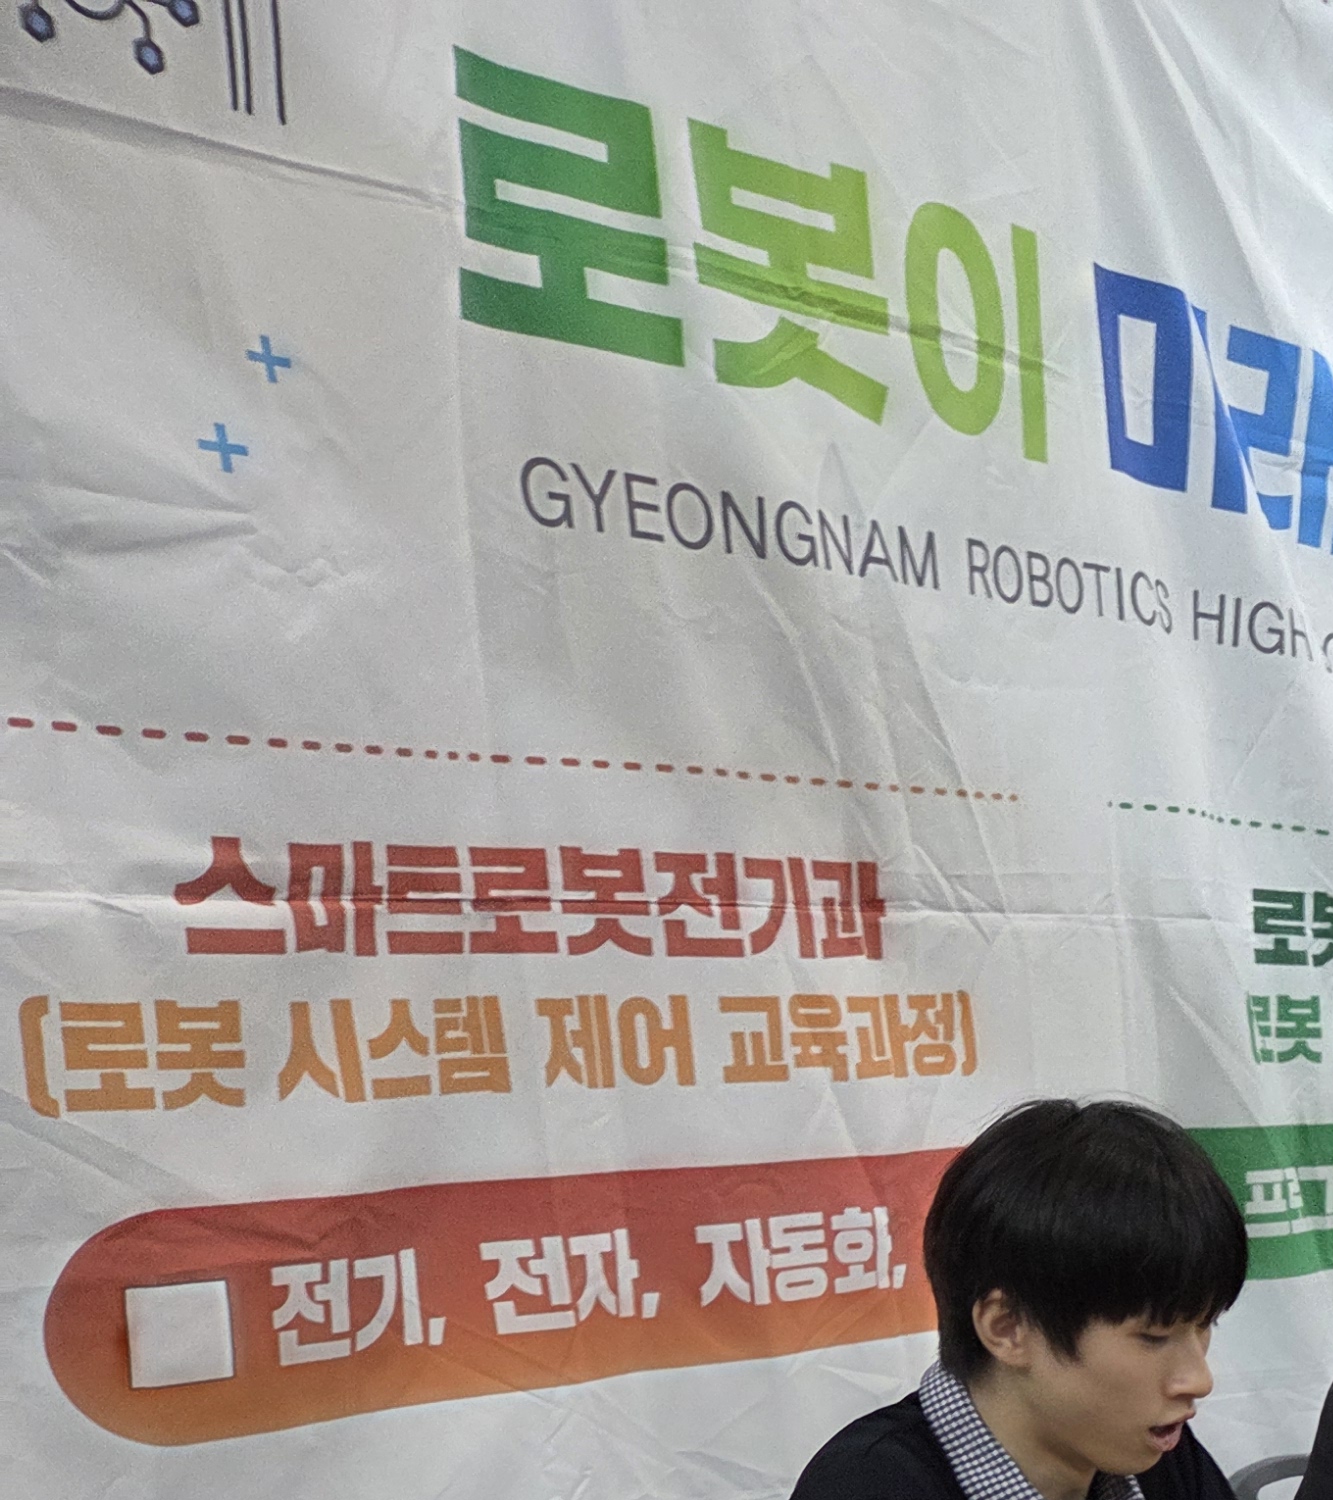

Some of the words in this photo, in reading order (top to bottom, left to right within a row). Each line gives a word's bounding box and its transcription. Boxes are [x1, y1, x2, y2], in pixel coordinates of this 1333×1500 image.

[453, 45, 1049, 462] 로봇이
[520, 456, 940, 592] GYEONGNAM
[968, 541, 1172, 635] ROBOTICS
[173, 836, 886, 961] 스마트로봇전기과
[279, 995, 512, 1102] 시스템
[539, 993, 696, 1089] 제어
[720, 989, 979, 1086] 교육과정)
[270, 1248, 448, 1367] 전기,
[482, 1231, 661, 1335] 전자,
[693, 1206, 907, 1308] 자동화,
